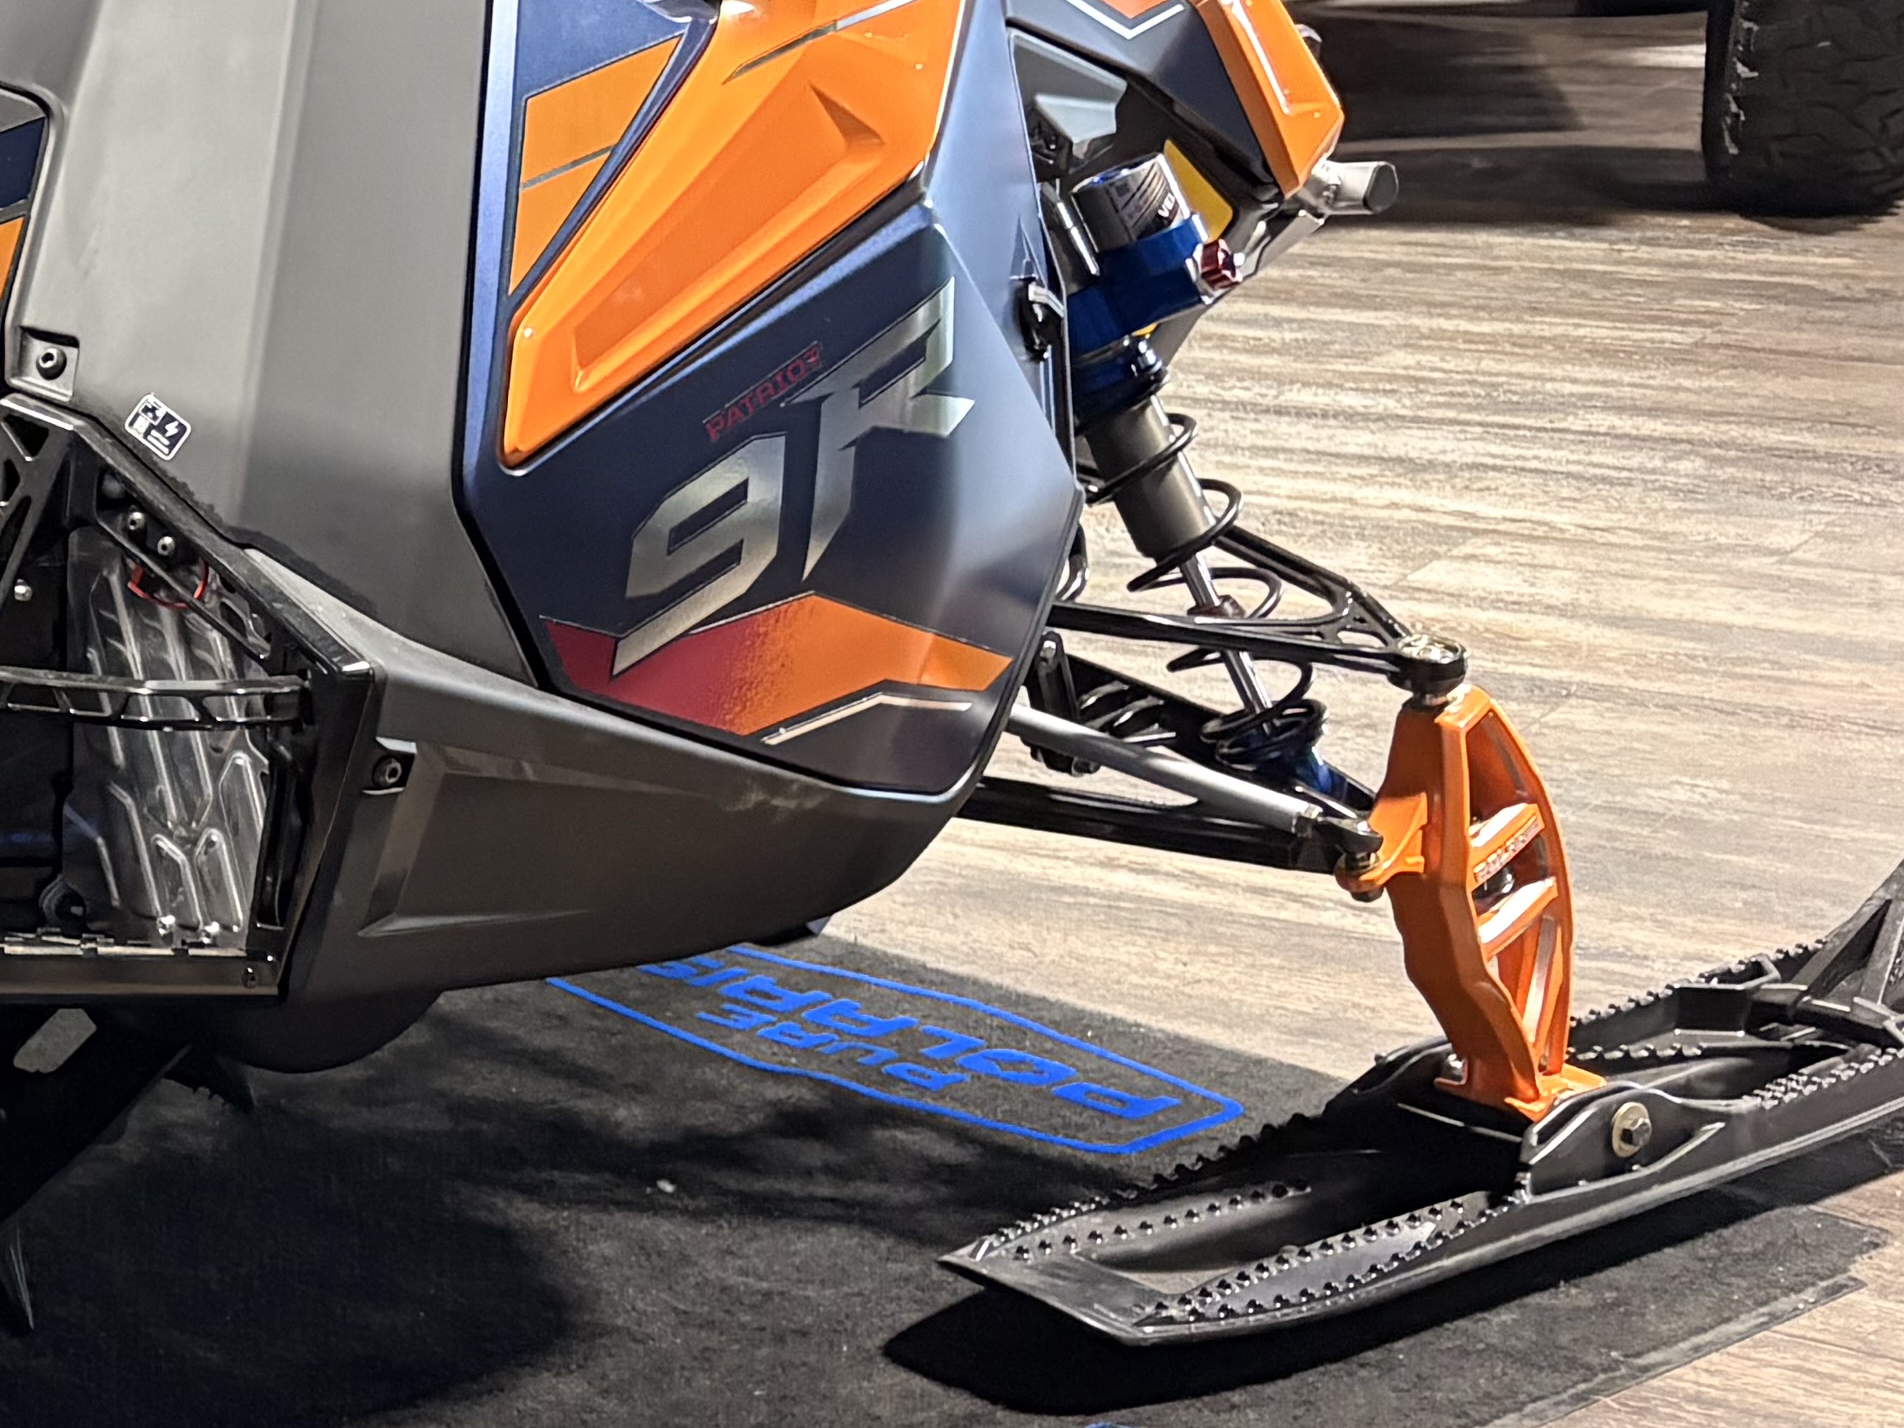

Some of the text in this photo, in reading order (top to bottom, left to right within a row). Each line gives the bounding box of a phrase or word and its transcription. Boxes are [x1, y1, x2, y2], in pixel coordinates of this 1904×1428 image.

[702, 339, 825, 444] PATRIOT
[612, 275, 976, 680] 9R
[694, 1001, 971, 1092] PURE
